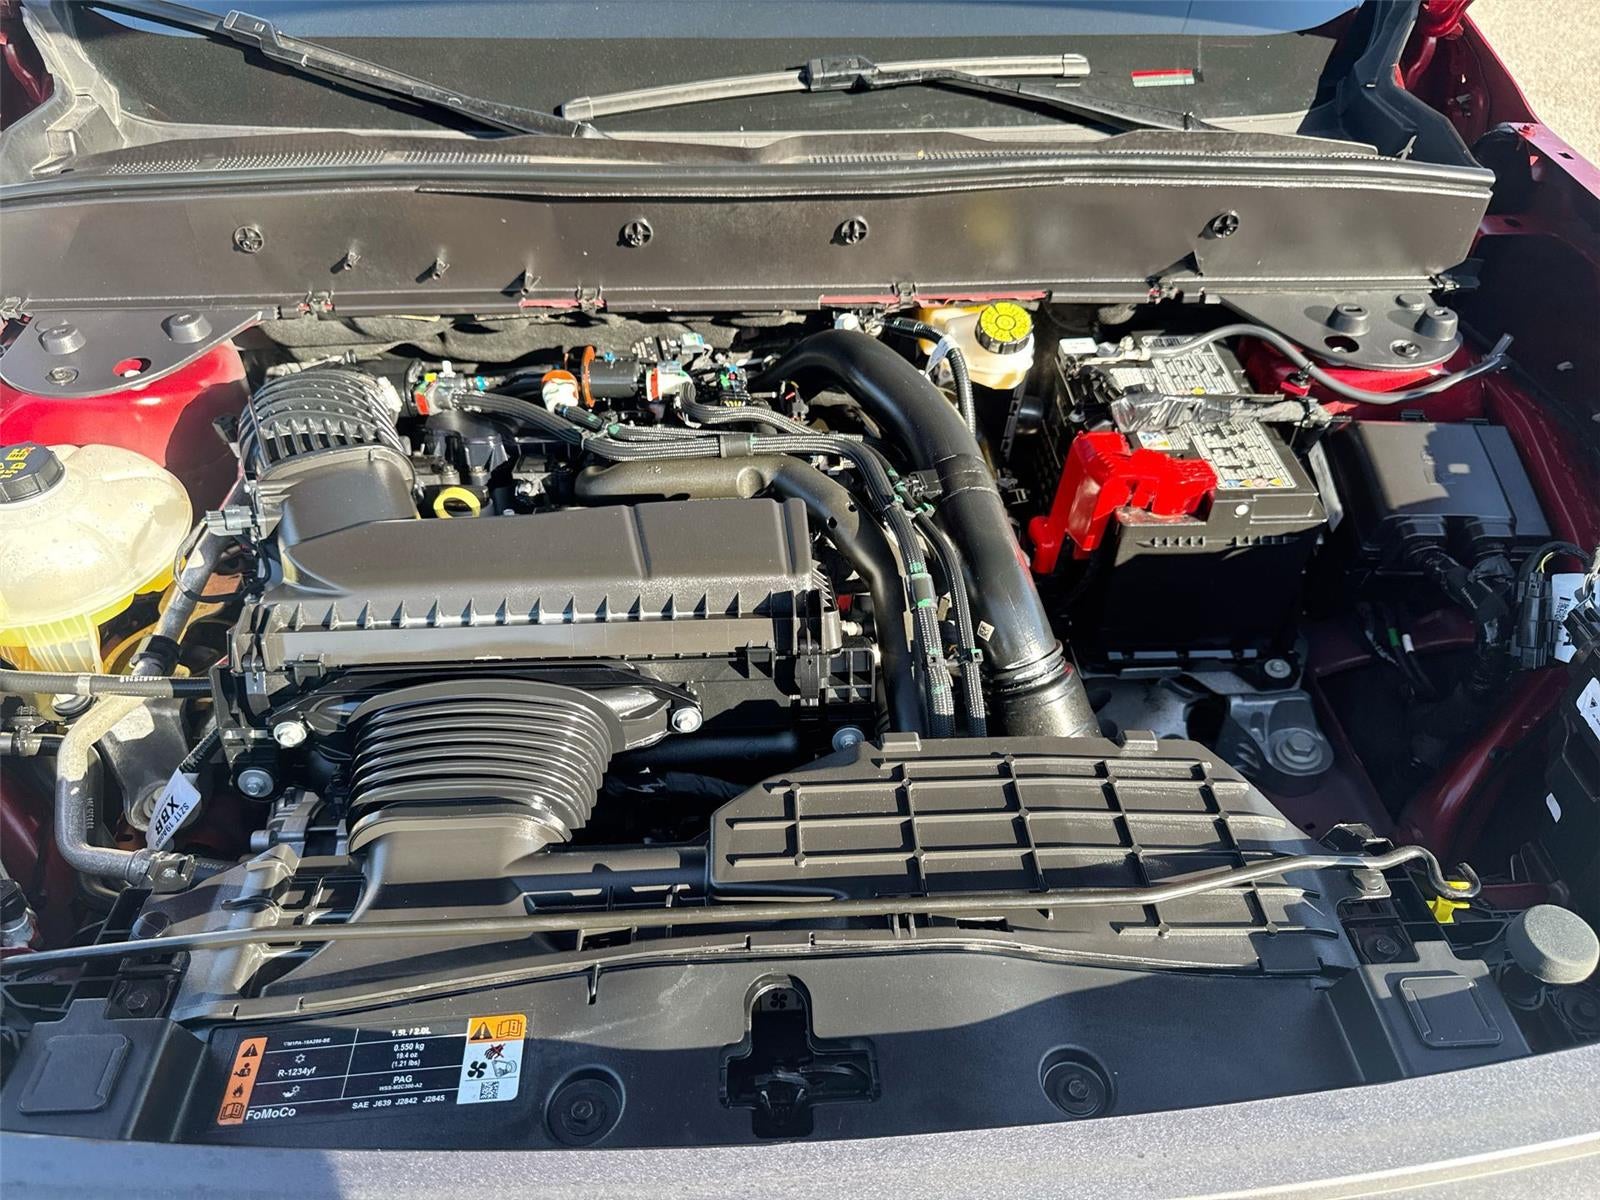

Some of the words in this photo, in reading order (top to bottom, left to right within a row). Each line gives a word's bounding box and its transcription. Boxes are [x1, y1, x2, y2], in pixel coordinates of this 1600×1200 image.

[155, 796, 180, 836] XBB
[393, 1043, 413, 1052] 0.550
[414, 1043, 425, 1051] kg
[391, 1060, 407, 1069] (1.21
[408, 1059, 421, 1067] lbs)
[277, 1066, 317, 1077] R-1234yf
[393, 1074, 413, 1084] PAG
[352, 1101, 370, 1110] SAE
[372, 1099, 392, 1108] J639
[394, 1097, 418, 1106] J2842
[422, 1094, 445, 1103] J2845
[245, 1106, 297, 1121] FoMoCo
